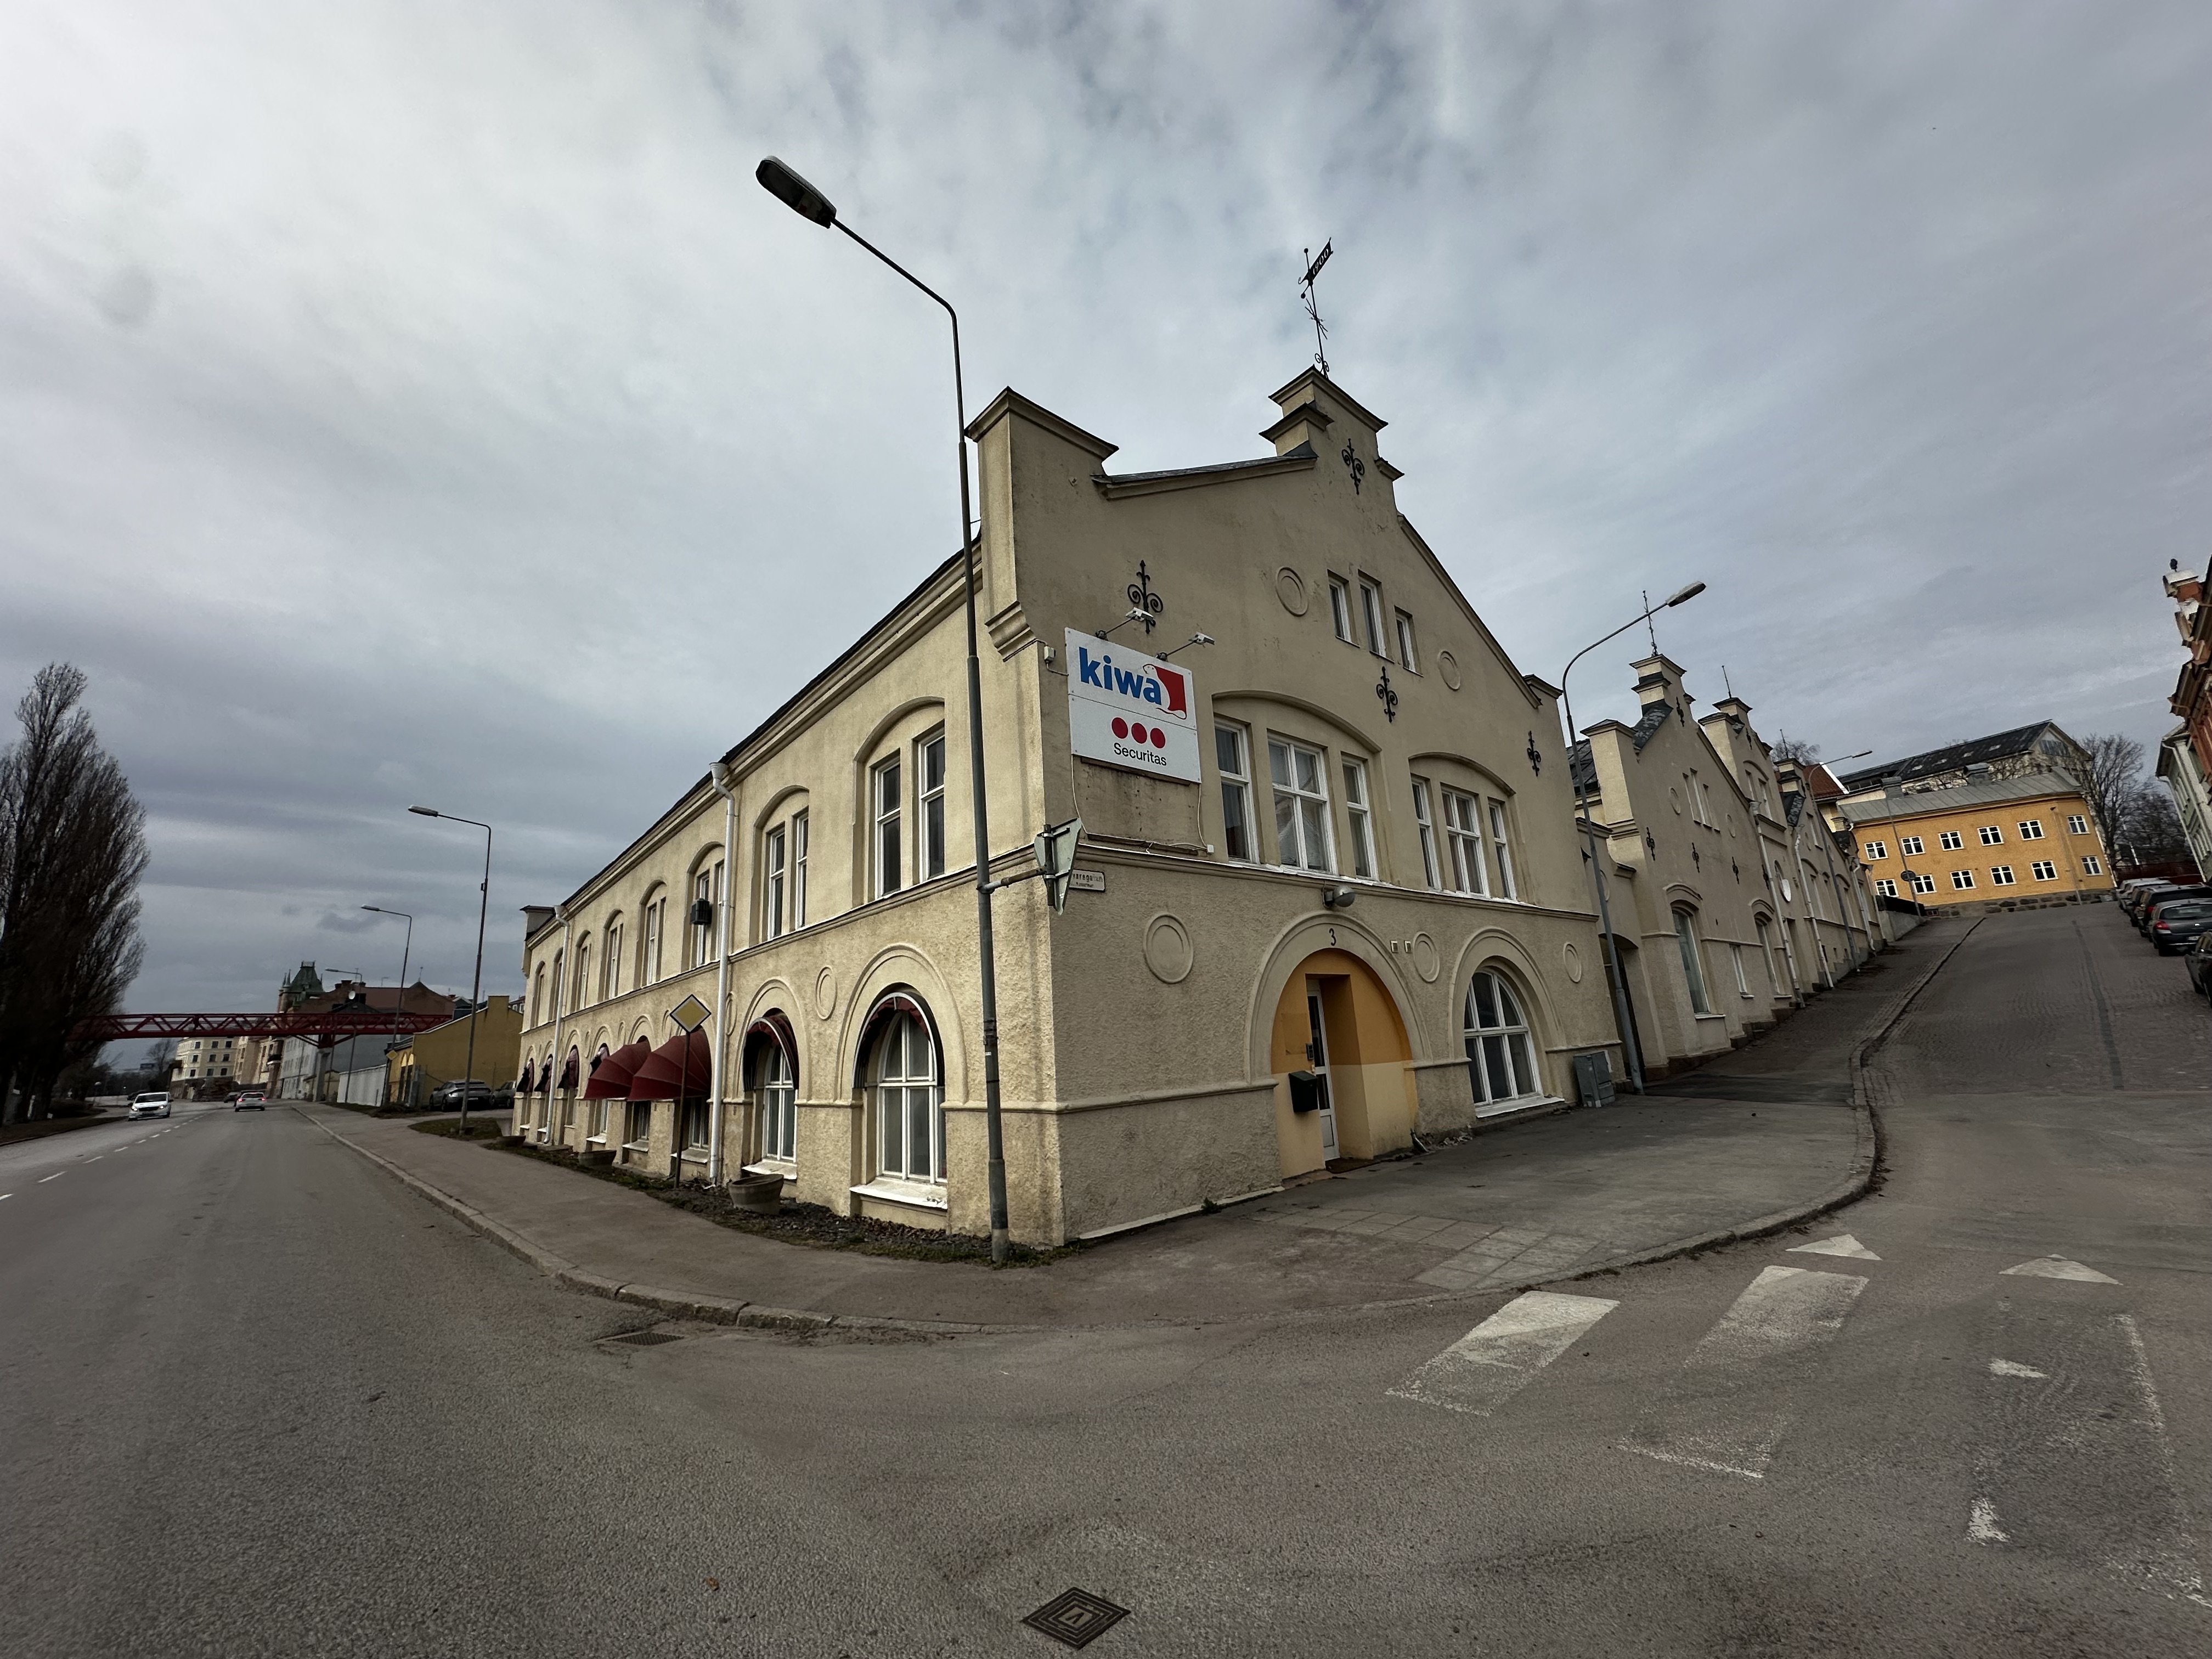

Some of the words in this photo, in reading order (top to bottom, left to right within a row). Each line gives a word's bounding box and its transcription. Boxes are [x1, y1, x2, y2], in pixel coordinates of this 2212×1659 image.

[1313, 248, 1329, 275] 1900
[1079, 646, 1161, 706] kiwa
[1114, 742, 1167, 766] Securitas
[1329, 928, 1336, 946] 3
